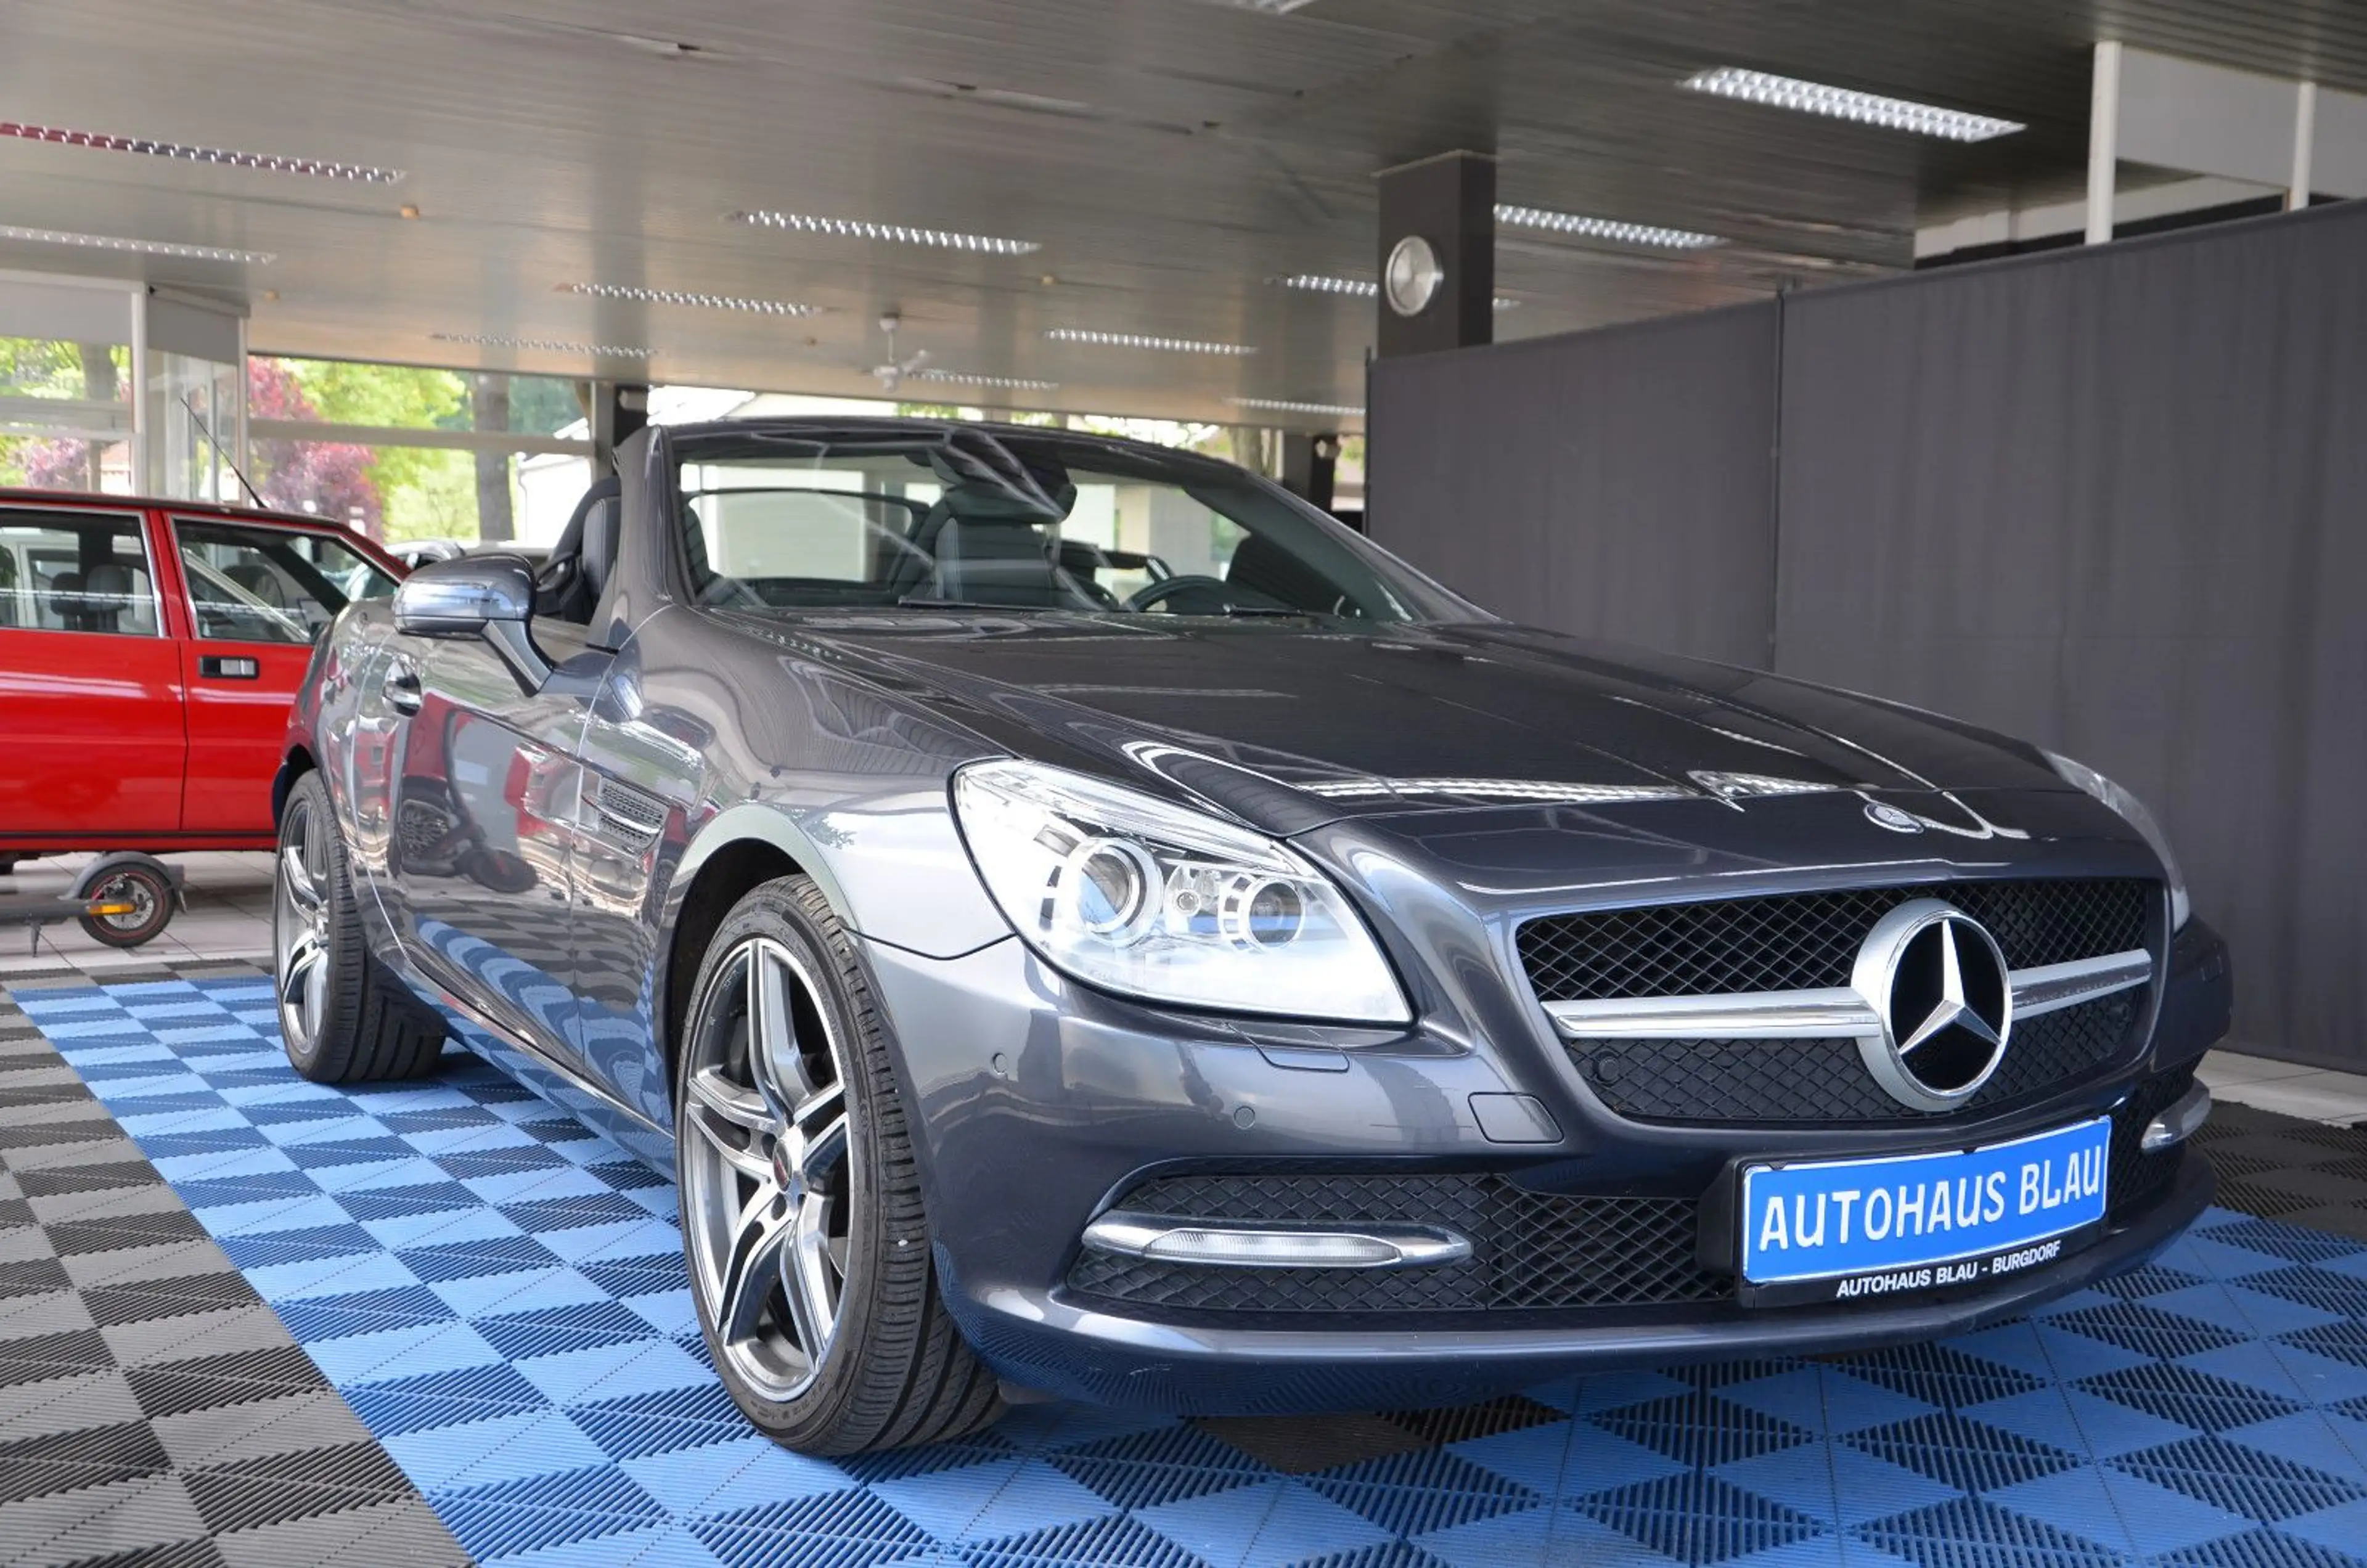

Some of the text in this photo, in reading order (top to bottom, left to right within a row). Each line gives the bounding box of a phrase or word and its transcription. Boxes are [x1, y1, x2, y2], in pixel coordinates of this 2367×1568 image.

[1759, 1146, 2101, 1251] AUTOHAUS BLAU
[1836, 1269, 1931, 1298] AUTOHAUS
[1936, 1262, 1977, 1284] BLAU
[1992, 1239, 2061, 1274] BURGDORF
